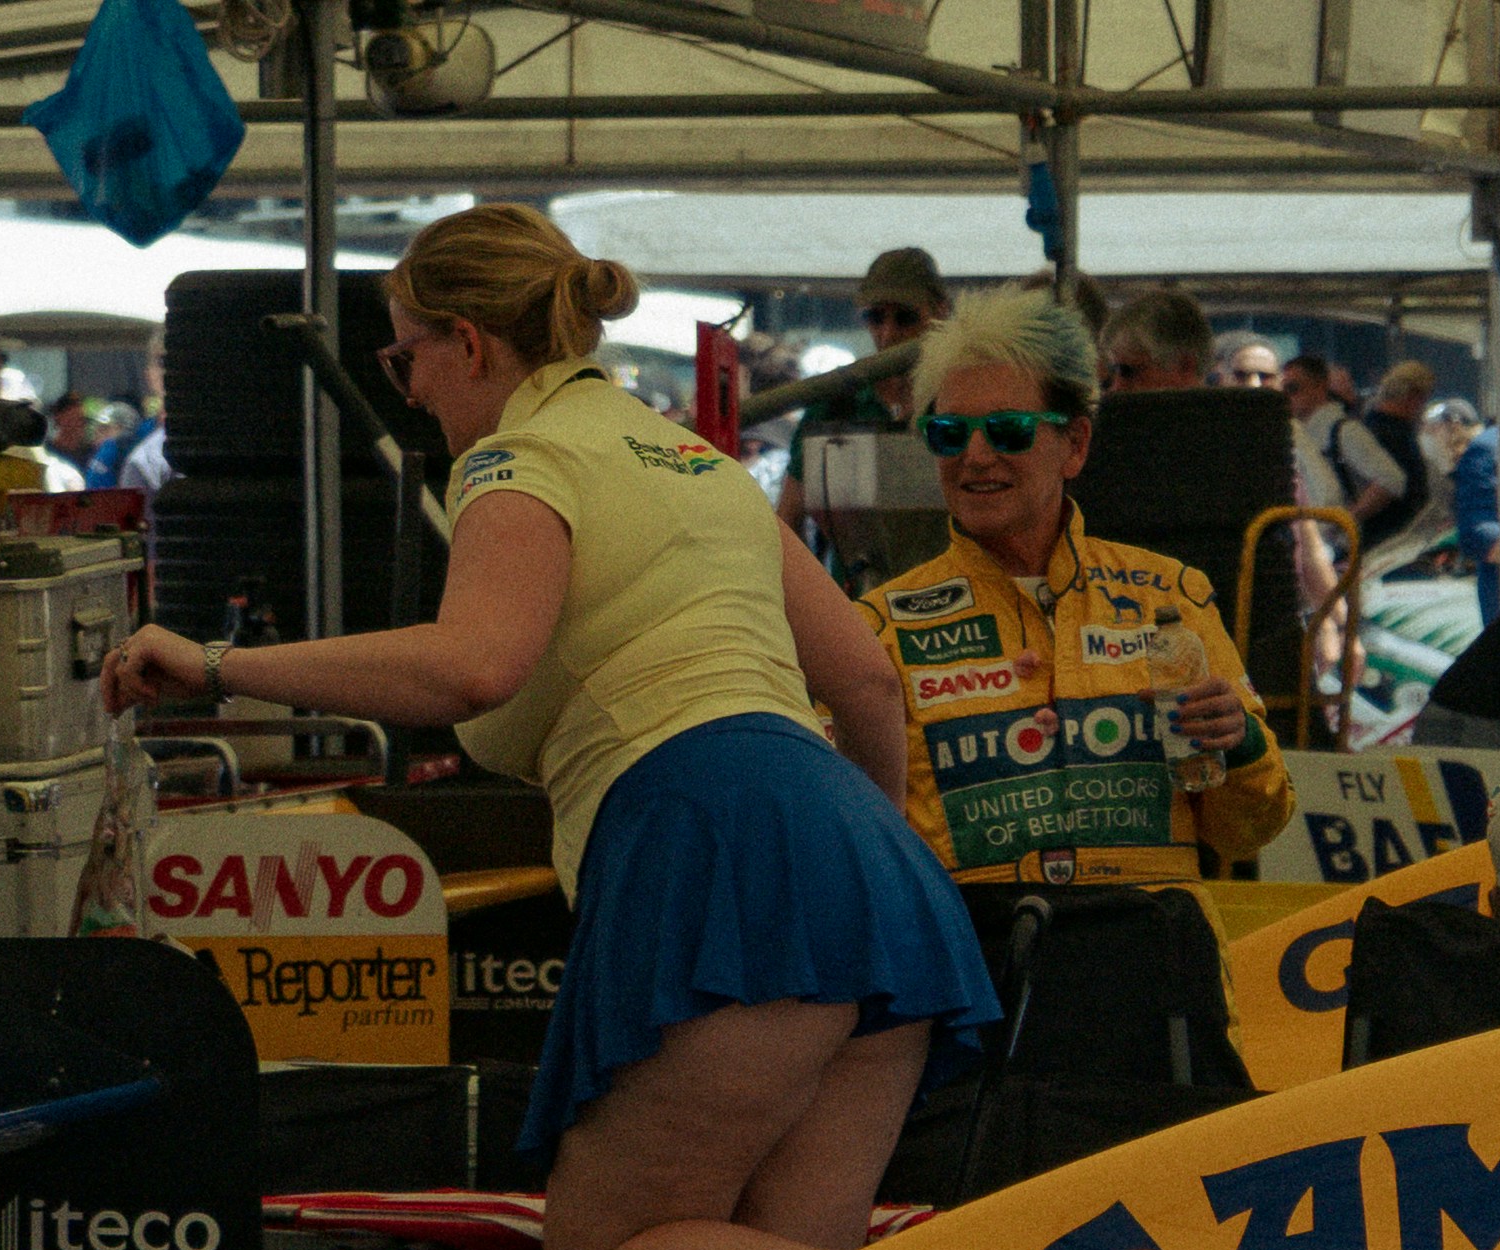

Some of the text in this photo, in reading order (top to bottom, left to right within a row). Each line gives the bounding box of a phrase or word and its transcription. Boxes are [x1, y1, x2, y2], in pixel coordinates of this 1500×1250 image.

[909, 622, 991, 654] VIVIL
[918, 668, 1014, 701] SANYO
[935, 704, 1160, 770] AUTOPOLI
[962, 776, 1160, 825] UNITED COLORS
[1336, 770, 1387, 802] FLY
[984, 822, 1019, 847] OF
[147, 846, 426, 928] SANYO
[237, 946, 437, 1017] Reporter
[342, 1004, 435, 1034] parfum
